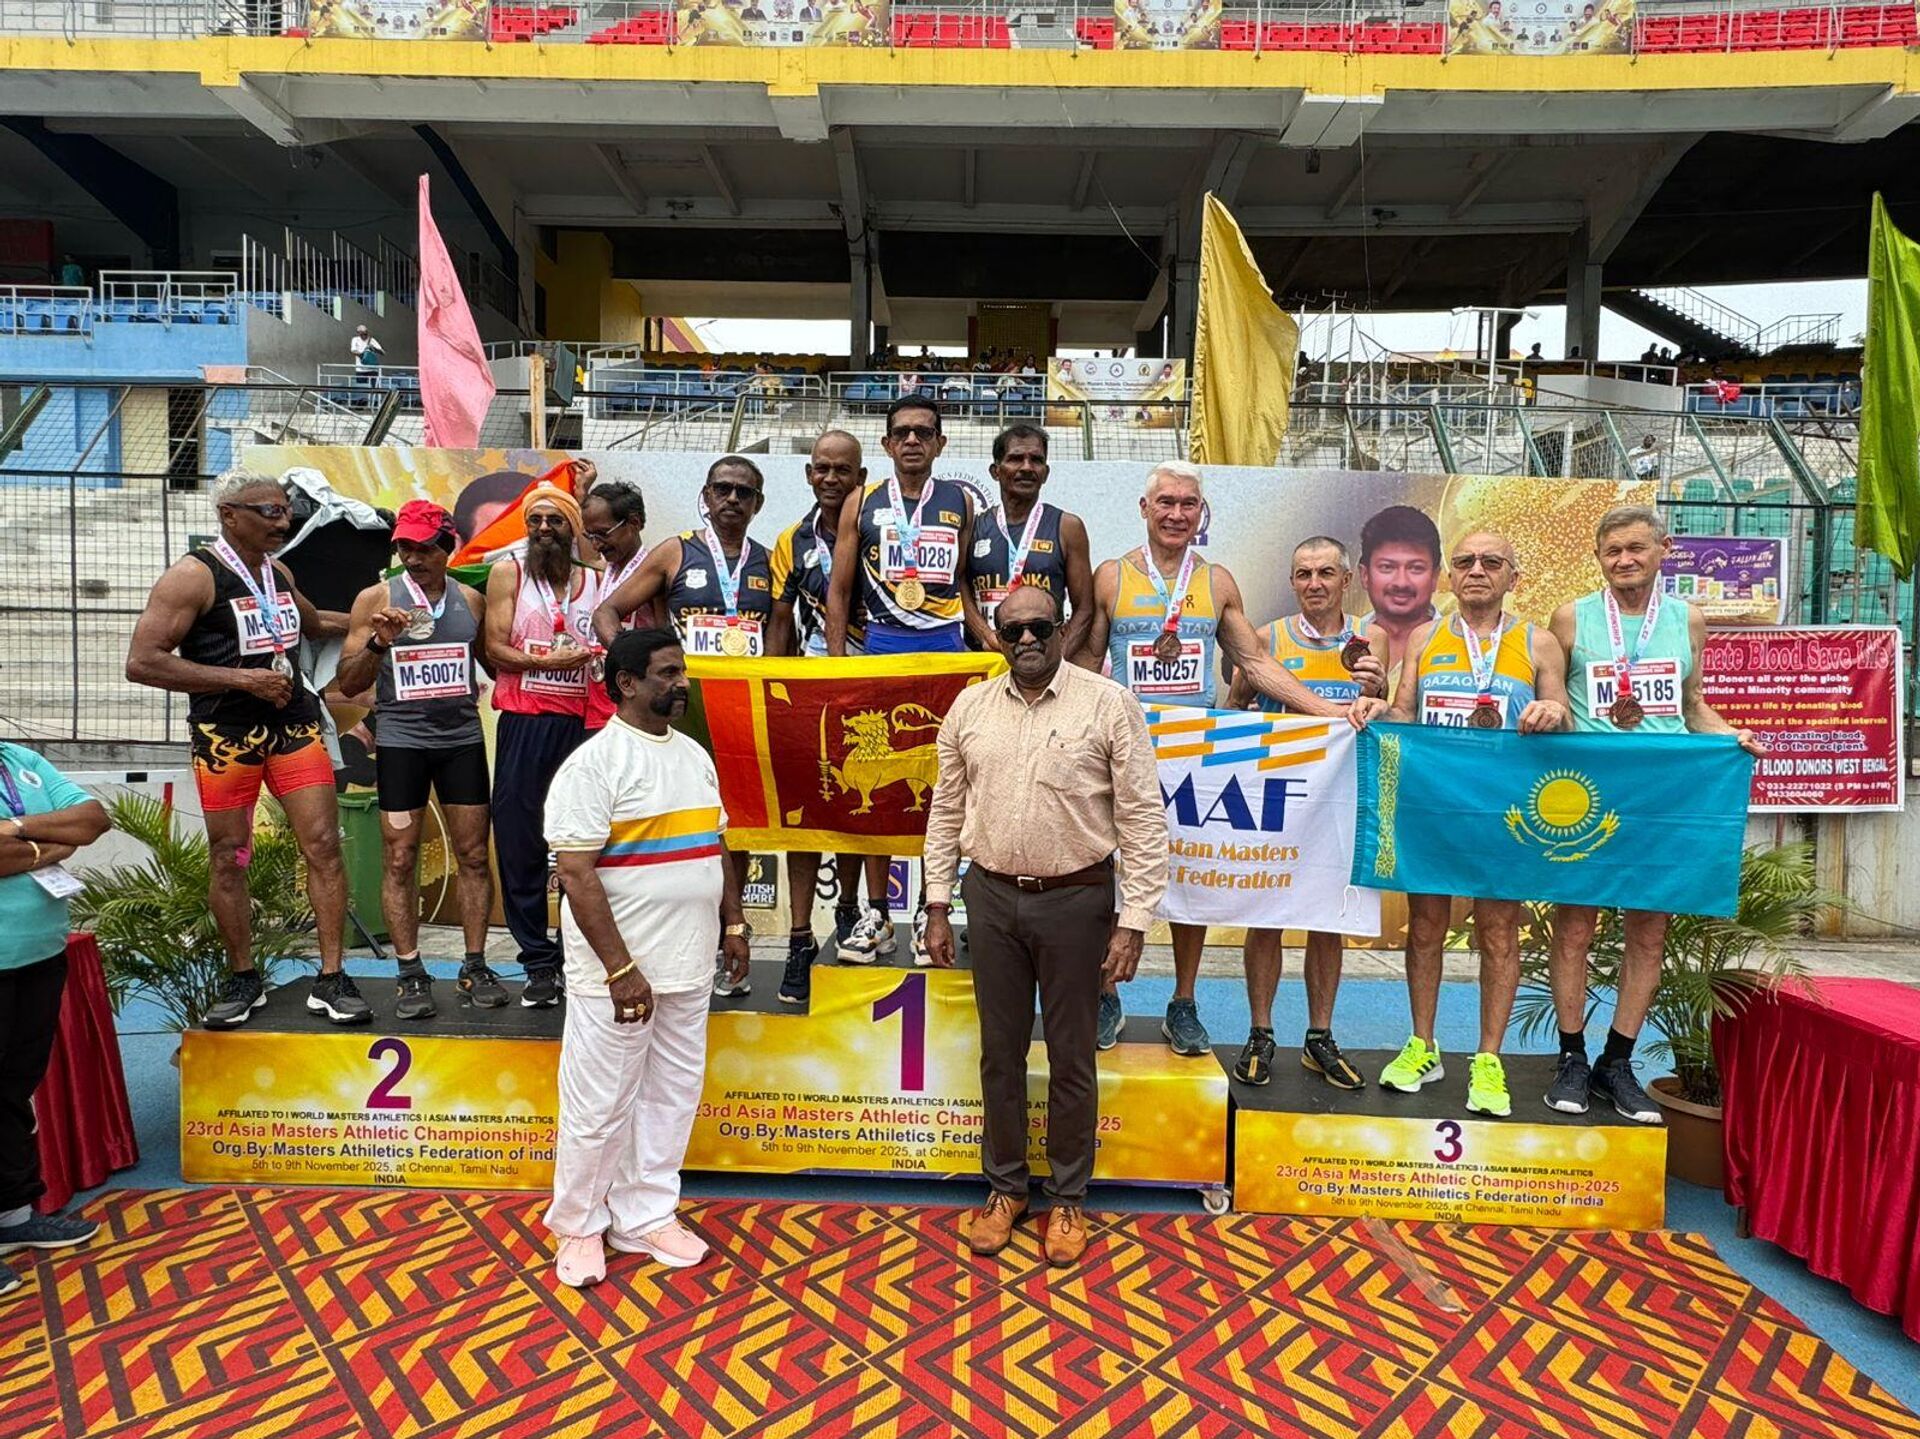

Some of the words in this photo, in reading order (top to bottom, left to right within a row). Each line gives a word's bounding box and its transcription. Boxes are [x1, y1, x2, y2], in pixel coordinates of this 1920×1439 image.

[888, 545, 952, 568] M0281
[995, 573, 1051, 591] LNKA
[694, 631, 758, 656] M-69
[1702, 642, 1744, 671] nate
[1748, 640, 1804, 671] Blood
[1807, 640, 1851, 670] Save
[399, 662, 465, 688] M-60074
[1133, 659, 1199, 682] M-60257
[1718, 675, 1754, 683] Donors
[1757, 675, 1770, 683] all
[1800, 675, 1817, 683] the
[1820, 674, 1849, 684] globe
[1313, 686, 1359, 699] QSTAN
[1423, 676, 1513, 693] QAZAQAN
[1597, 679, 1674, 703] M-5185
[1702, 686, 1735, 694] stitute
[1747, 686, 1791, 696] Minority
[1794, 686, 1853, 696] community
[1781, 702, 1793, 711] by
[1795, 702, 1837, 711] donating
[1761, 732, 1775, 742] by
[1779, 731, 1830, 742] donating
[1776, 743, 1788, 751] to
[1790, 742, 1811, 751] the
[1762, 759, 1794, 776] BLOOD
[1795, 759, 1833, 775] DONORS
[1835, 759, 1861, 774] WEST
[1168, 838, 1213, 858] stan
[1217, 840, 1299, 862] Masters
[1176, 866, 1292, 889] Federation
[741, 893, 776, 904] MPIRE
[871, 973, 926, 1091] 1
[366, 1038, 412, 1109] 2
[725, 1091, 780, 1101] AFFILIATED
[783, 1093, 795, 1101] TO
[803, 1094, 840, 1103] WORLD
[842, 1095, 889, 1104] MASTERS
[891, 1096, 946, 1106] ATHLETICS
[952, 1098, 982, 1107] ASIAN
[217, 1110, 269, 1119] AFFILIATED
[273, 1111, 284, 1119] TO
[290, 1112, 324, 1120] WORLD
[327, 1112, 370, 1121] MASTERS
[372, 1113, 421, 1122] ATHLETICS
[429, 1114, 457, 1122] ASIAN
[459, 1115, 502, 1123] MASTERS
[504, 1115, 554, 1124] ATHLETICS
[736, 1104, 776, 1119] Asia
[783, 1106, 854, 1122] Masters
[859, 1108, 930, 1125] Athletic
[187, 1121, 224, 1137] 23rd
[229, 1122, 266, 1137] Asia
[272, 1123, 338, 1138] Masters
[344, 1125, 409, 1140] Athletic
[855, 1128, 935, 1143] Athiletics
[761, 1143, 779, 1152] 5th
[783, 1144, 793, 1153] to
[797, 1144, 814, 1153] 9th
[817, 1144, 876, 1156] November
[915, 1148, 927, 1157] at
[1434, 1120, 1462, 1163] 3
[340, 1143, 414, 1158] Athiletics
[420, 1145, 503, 1160] Federation
[509, 1147, 524, 1160] of
[529, 1148, 557, 1161] indi
[252, 1160, 268, 1170] 5th
[272, 1161, 282, 1170] to
[286, 1160, 301, 1170] 9th
[305, 1160, 360, 1171] November
[396, 1163, 406, 1172] at
[460, 1164, 487, 1174] Tamil
[490, 1164, 519, 1175] Nadu
[891, 1159, 926, 1169] INDIA
[1303, 1157, 1347, 1166] AFFILIATED
[1396, 1161, 1434, 1169] MASTERS
[1435, 1163, 1478, 1172] ATHLETICS
[1484, 1165, 1508, 1173] ASIAN
[1510, 1167, 1548, 1175] MASTERS
[1550, 1168, 1593, 1177] ATHLETICS
[374, 1175, 406, 1184] INDIA
[1276, 1165, 1308, 1178] 23rd
[1312, 1167, 1343, 1180] Asia
[1349, 1169, 1406, 1182] Masters
[1410, 1171, 1467, 1186] Athletic
[1471, 1174, 1620, 1193] Championship-2025
[1407, 1185, 1470, 1200] Athiletics
[1475, 1189, 1548, 1204] Federation
[1553, 1193, 1566, 1205] of
[1571, 1194, 1604, 1207] india
[1331, 1197, 1345, 1205] 5th
[1348, 1198, 1356, 1206] to
[1359, 1198, 1373, 1206] 9th
[1376, 1199, 1423, 1209] November
[1454, 1203, 1463, 1211] at
[1510, 1205, 1533, 1215] Tamil
[1536, 1206, 1561, 1216] Nadu
[1435, 1212, 1462, 1221] INDIA
